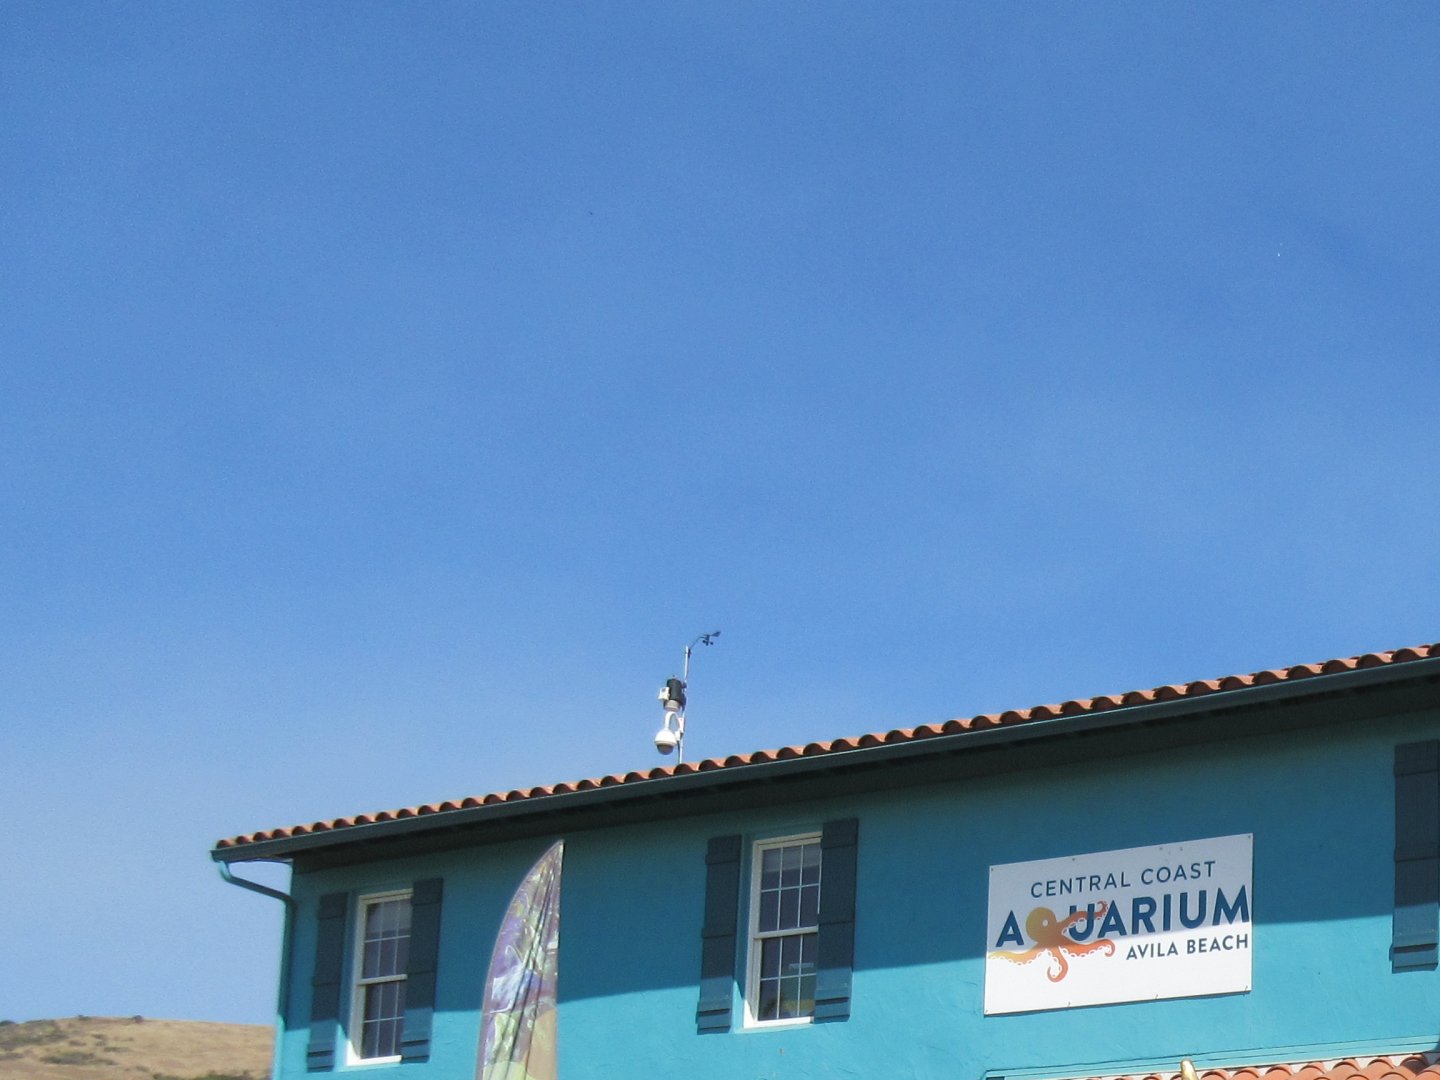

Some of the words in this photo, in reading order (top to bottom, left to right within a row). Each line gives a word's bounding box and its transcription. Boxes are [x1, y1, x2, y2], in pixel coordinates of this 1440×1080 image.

[1031, 871, 1131, 899] CENTRAL
[1141, 860, 1216, 885] COAST
[1126, 941, 1179, 960] AVILA
[1186, 934, 1249, 955] BEACH
